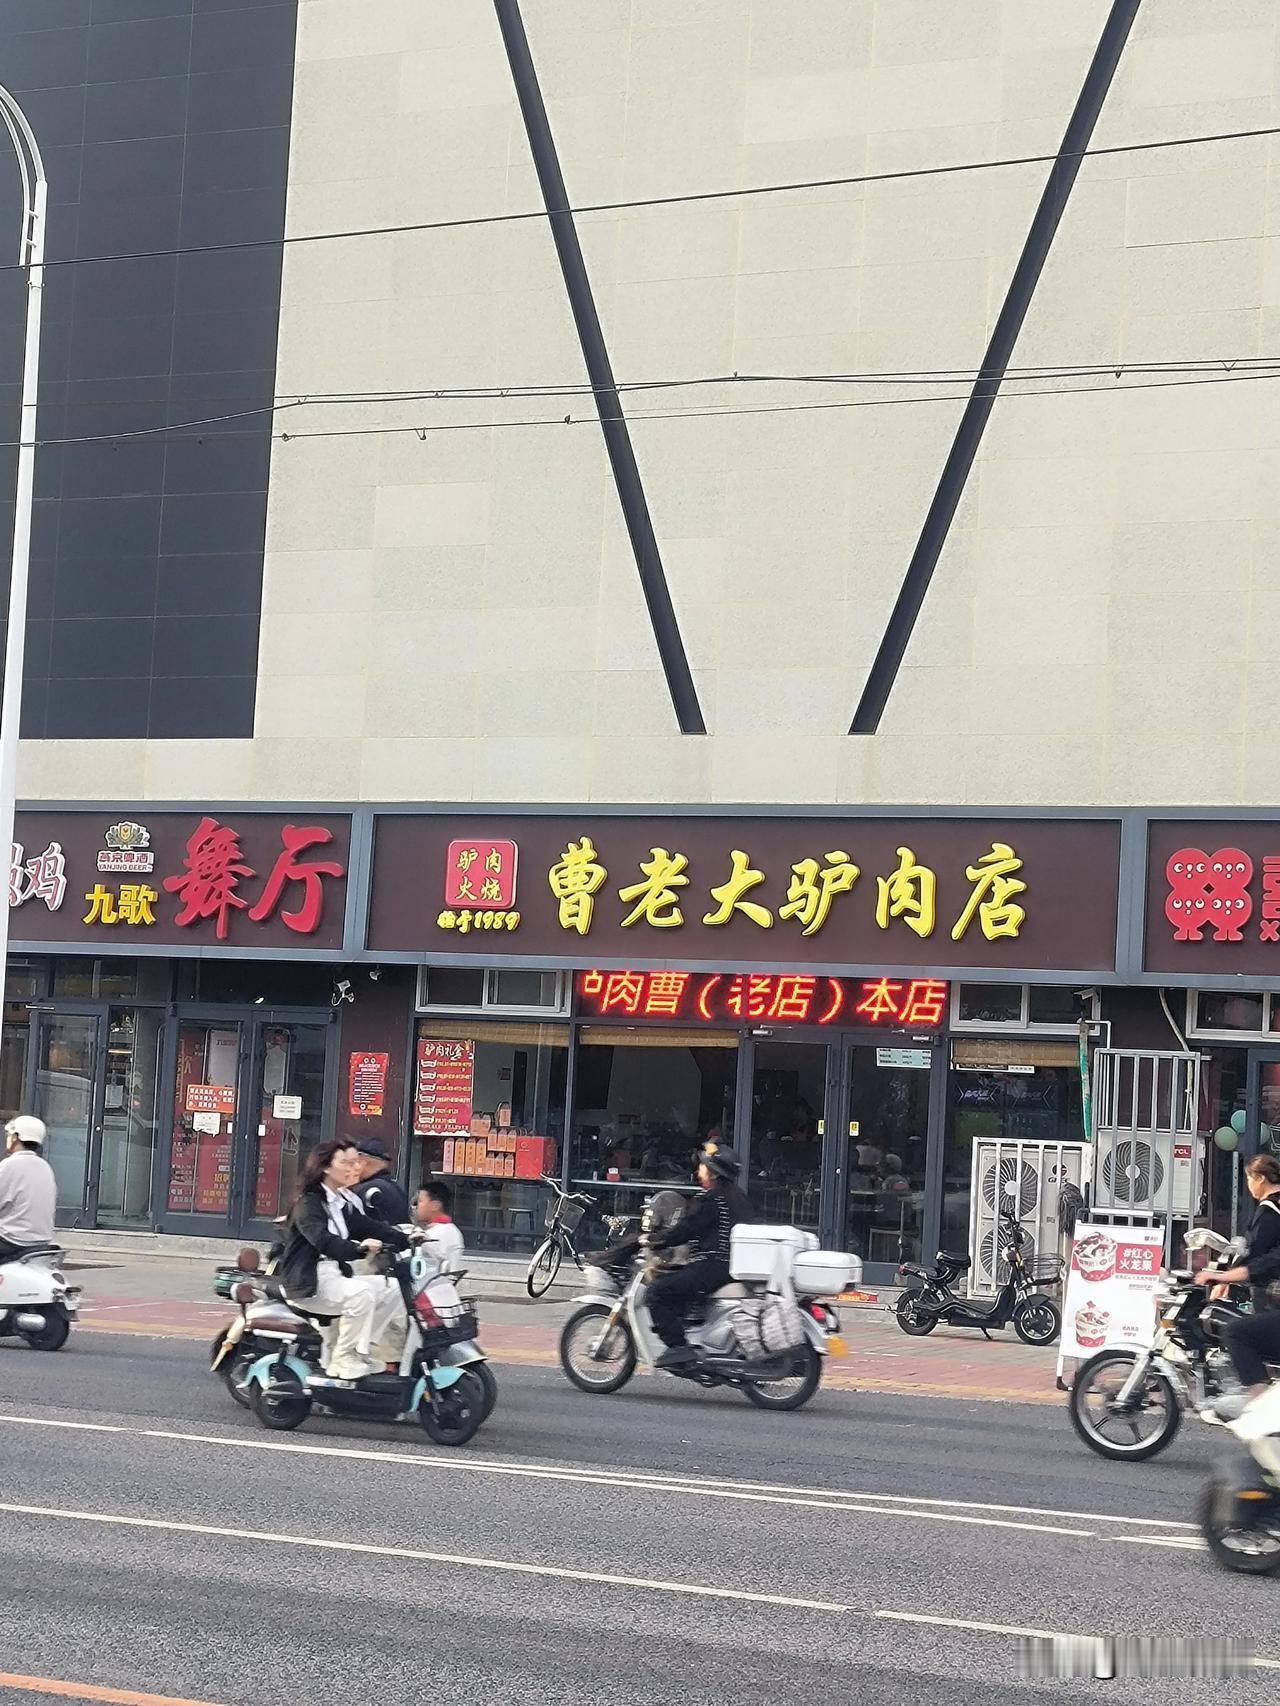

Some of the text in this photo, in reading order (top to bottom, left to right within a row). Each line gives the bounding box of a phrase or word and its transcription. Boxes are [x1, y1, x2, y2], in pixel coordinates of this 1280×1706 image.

[98, 852, 148, 863] 燕京啤酒
[456, 848, 502, 873] 驴肉
[163, 817, 345, 939] 舞厅
[455, 876, 502, 901] 火烧
[548, 836, 1027, 942] 曹老大驴肉店
[83, 884, 158, 925] 九歌
[1118, 1258, 1153, 1272] 火龙果
[1122, 1247, 1154, 1260] #红心
